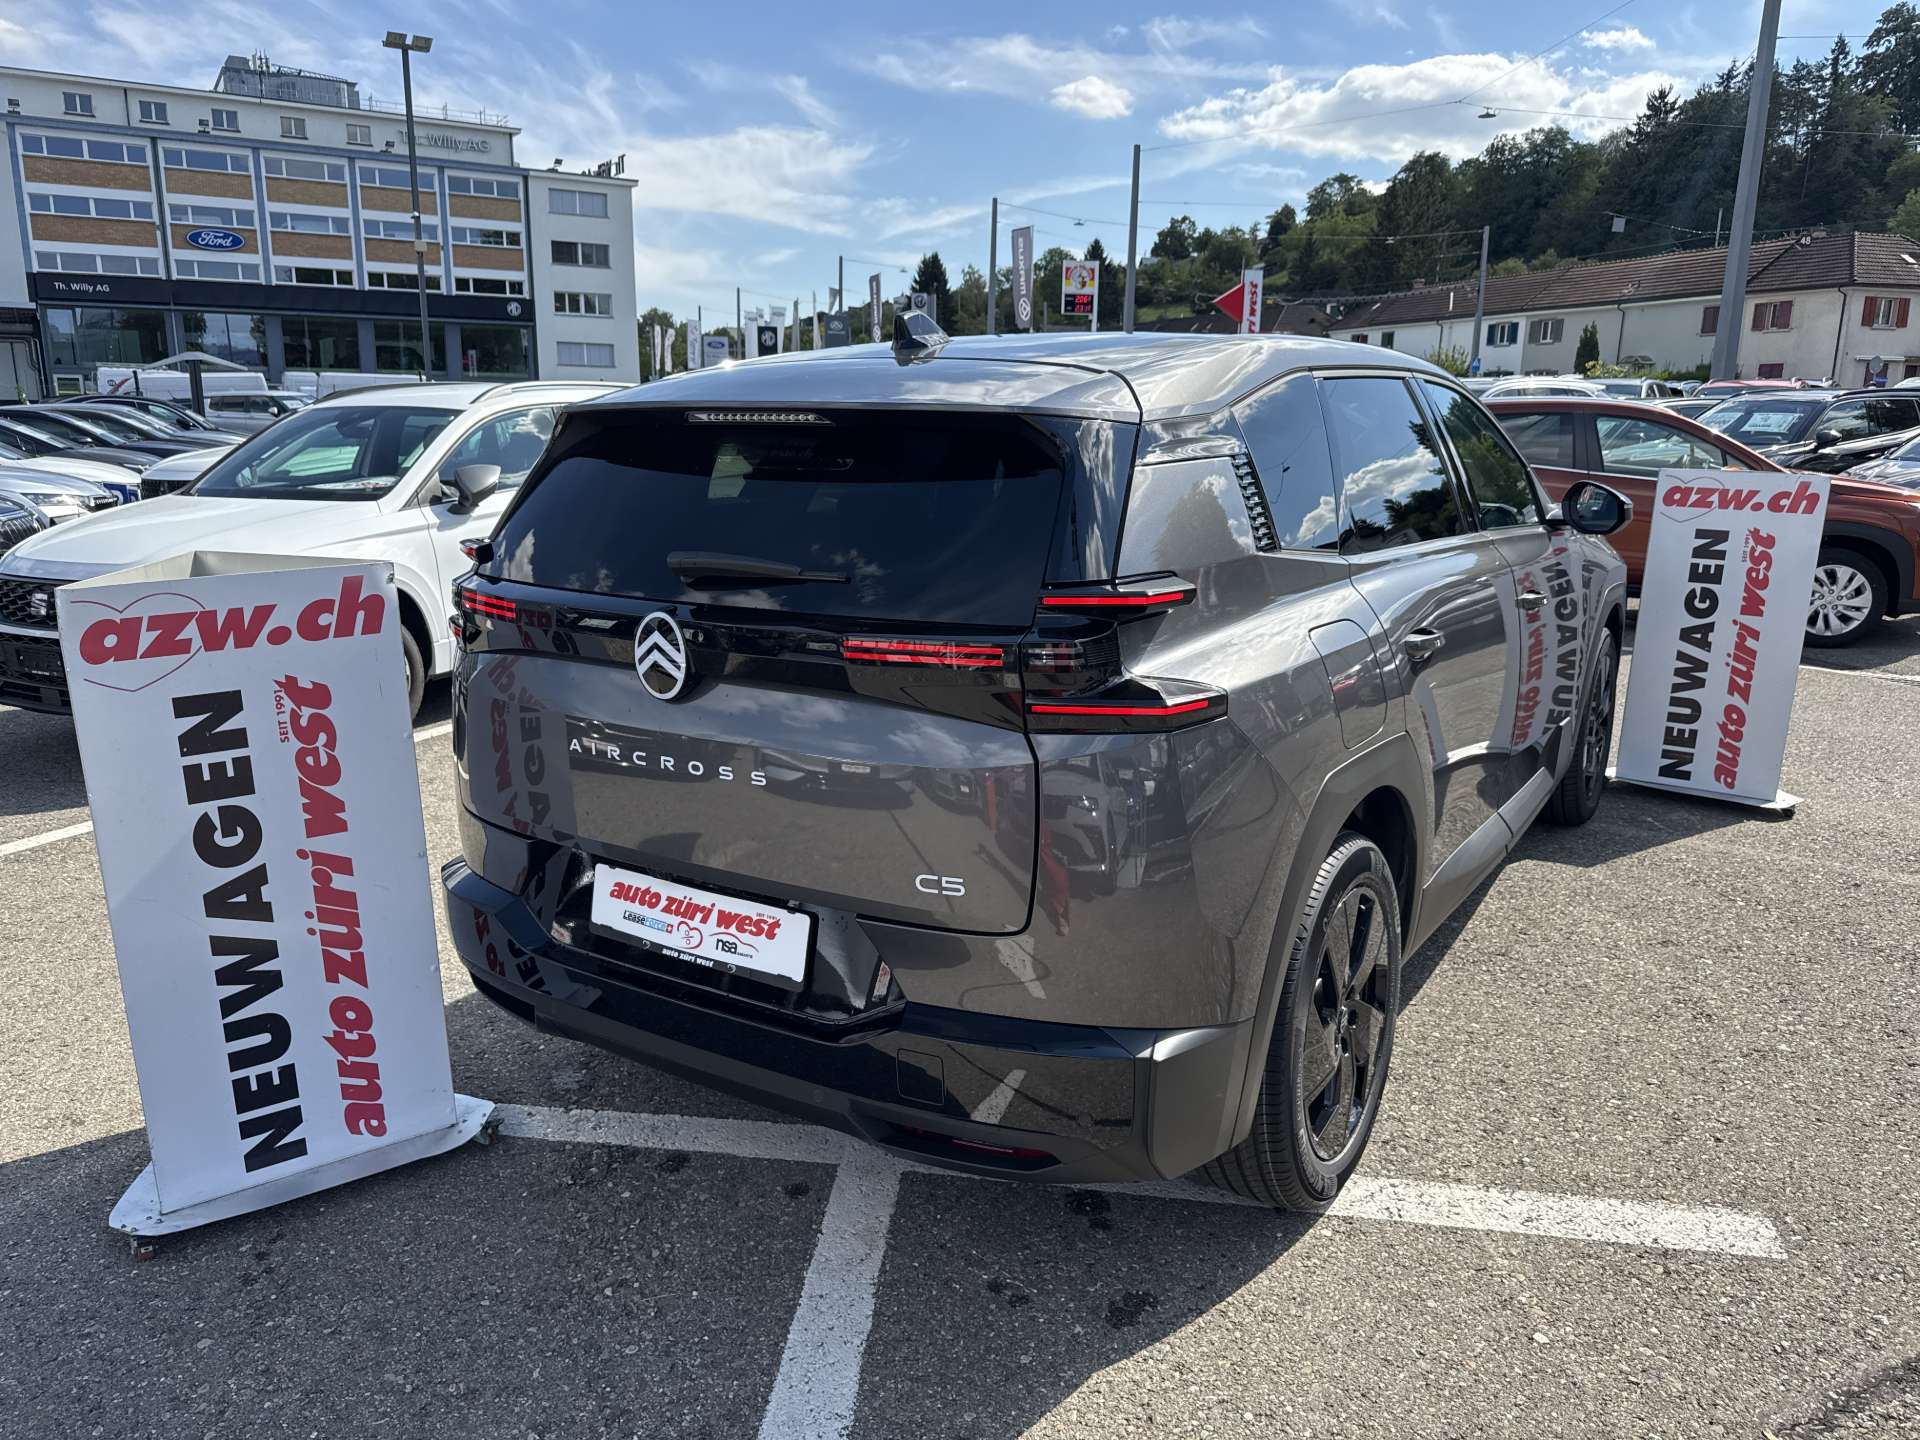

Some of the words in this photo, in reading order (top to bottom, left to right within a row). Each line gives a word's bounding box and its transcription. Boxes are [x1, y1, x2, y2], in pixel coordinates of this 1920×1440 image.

[427, 134, 464, 153] Willy
[466, 138, 492, 153] AG
[198, 231, 233, 247] Ford
[1800, 236, 1811, 245] 48
[54, 281, 68, 291] Th.
[70, 283, 94, 293] Willy
[96, 284, 110, 293] AG
[1662, 480, 1821, 515] azw.ch
[1739, 527, 1776, 618] west
[79, 575, 386, 666] azw.ch
[1658, 528, 1730, 781] NEUWAGEN
[1725, 619, 1761, 705] züri
[274, 690, 285, 716] 1991
[277, 720, 290, 743] SEIT
[1713, 703, 1747, 790] auto
[272, 673, 349, 839] west
[569, 738, 767, 786] AIRCROSS
[915, 874, 966, 897] C5
[171, 689, 308, 1174] NEUWAGEN
[296, 848, 369, 990] züri
[609, 880, 662, 910] auto
[661, 895, 716, 925] züri
[716, 908, 782, 941] west
[662, 947, 679, 958] auto
[696, 957, 714, 968] west
[715, 938, 738, 955] nsa
[322, 995, 388, 1138] auto
